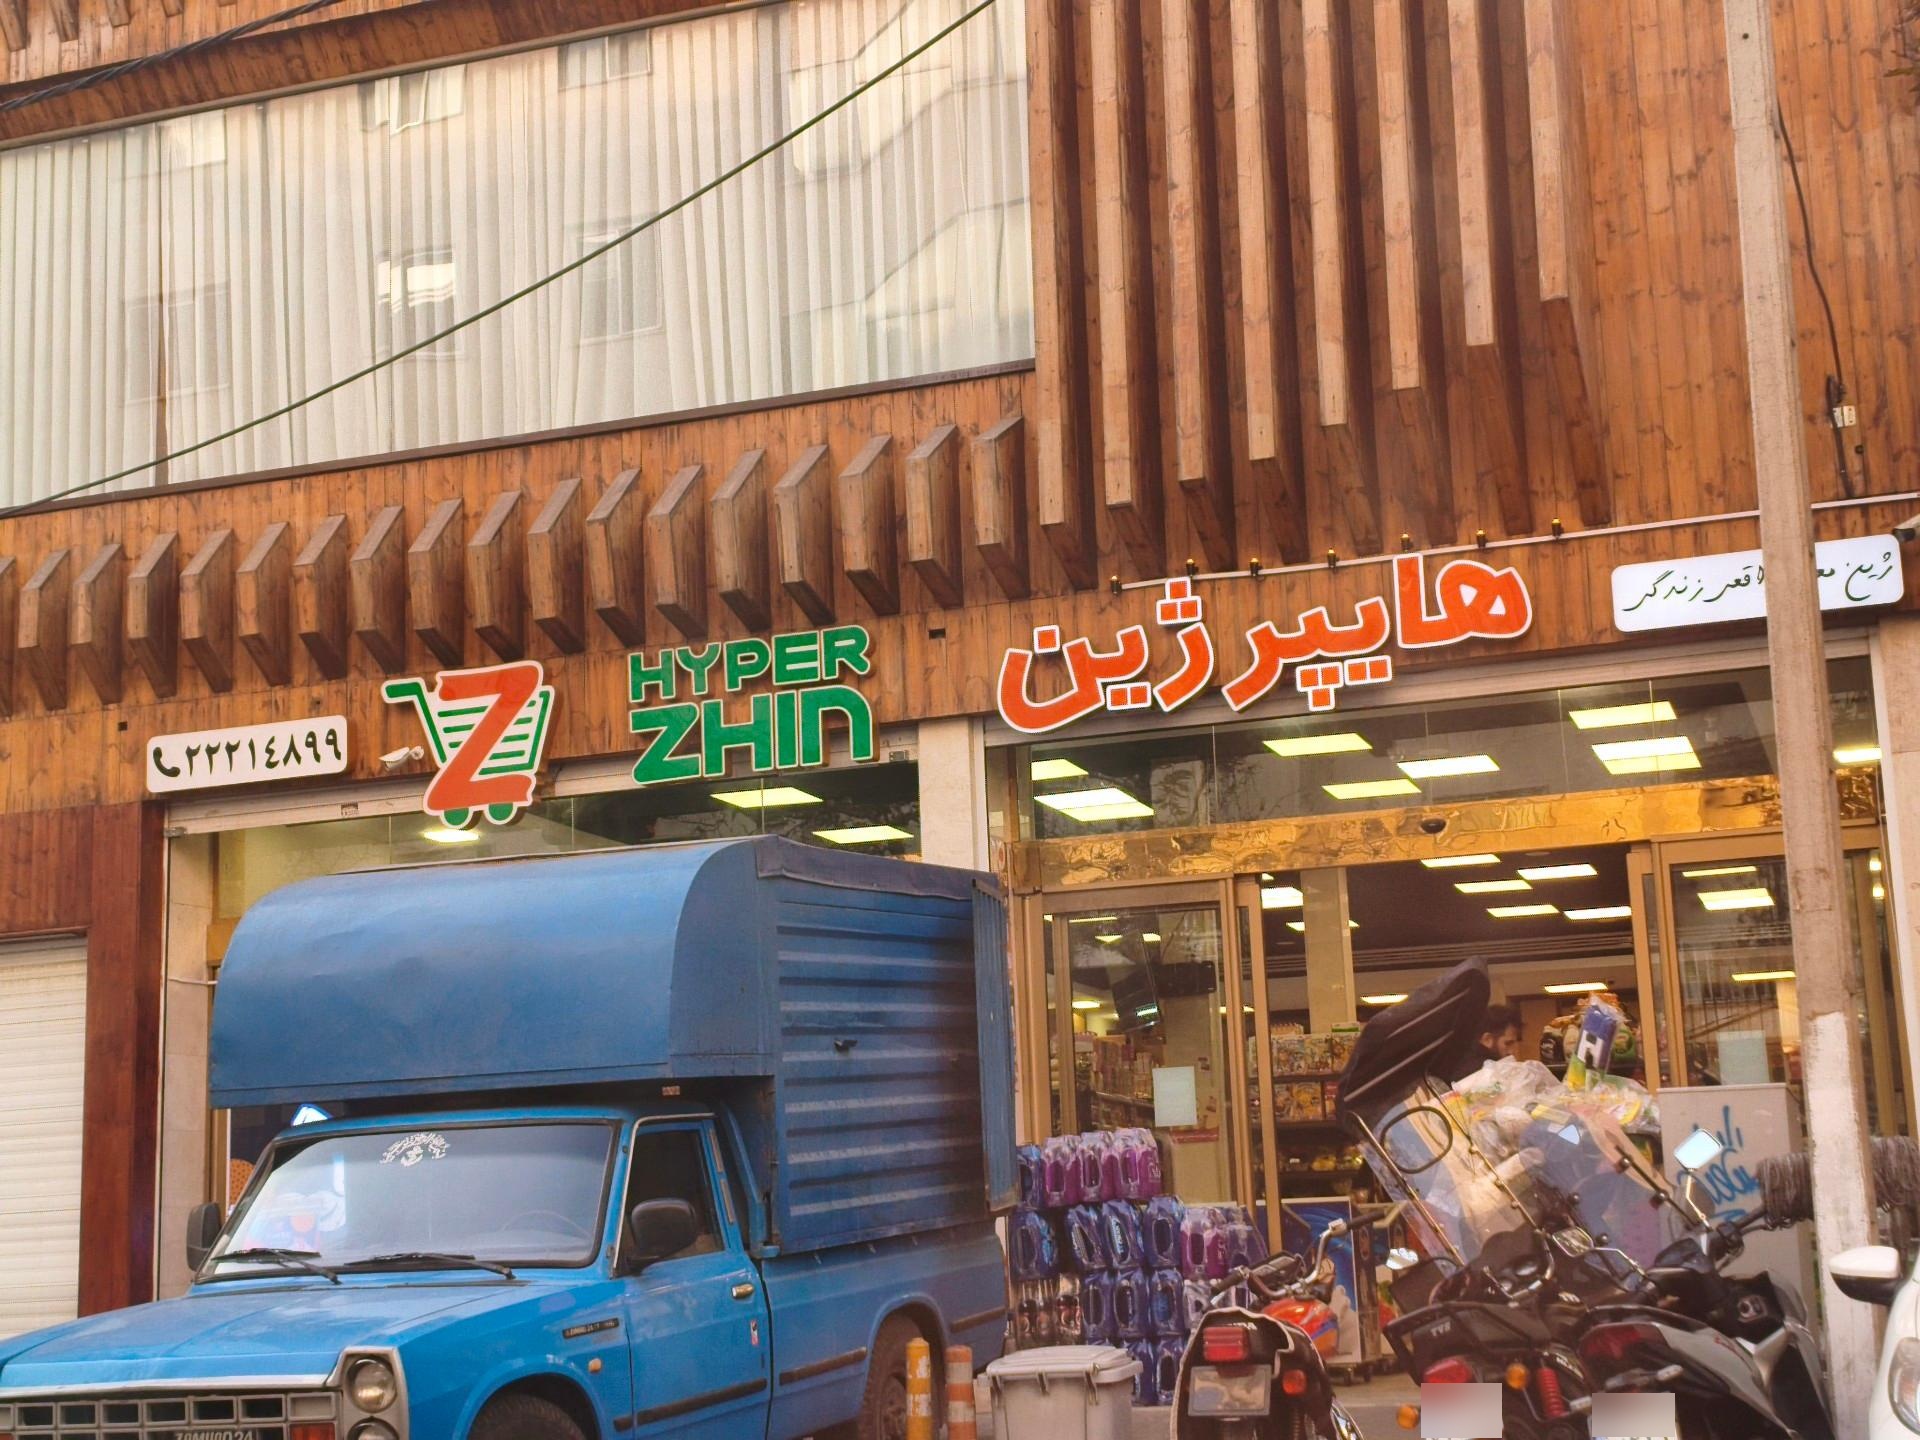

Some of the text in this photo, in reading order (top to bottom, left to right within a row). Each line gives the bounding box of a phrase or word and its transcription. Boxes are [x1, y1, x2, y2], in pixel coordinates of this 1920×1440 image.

[1703, 565, 1764, 602] اقعی
[628, 625, 871, 703] HYPER
[997, 553, 1532, 733] هایپر ژین
[185, 728, 342, 777] ٢٢٢١٤٨٩٩
